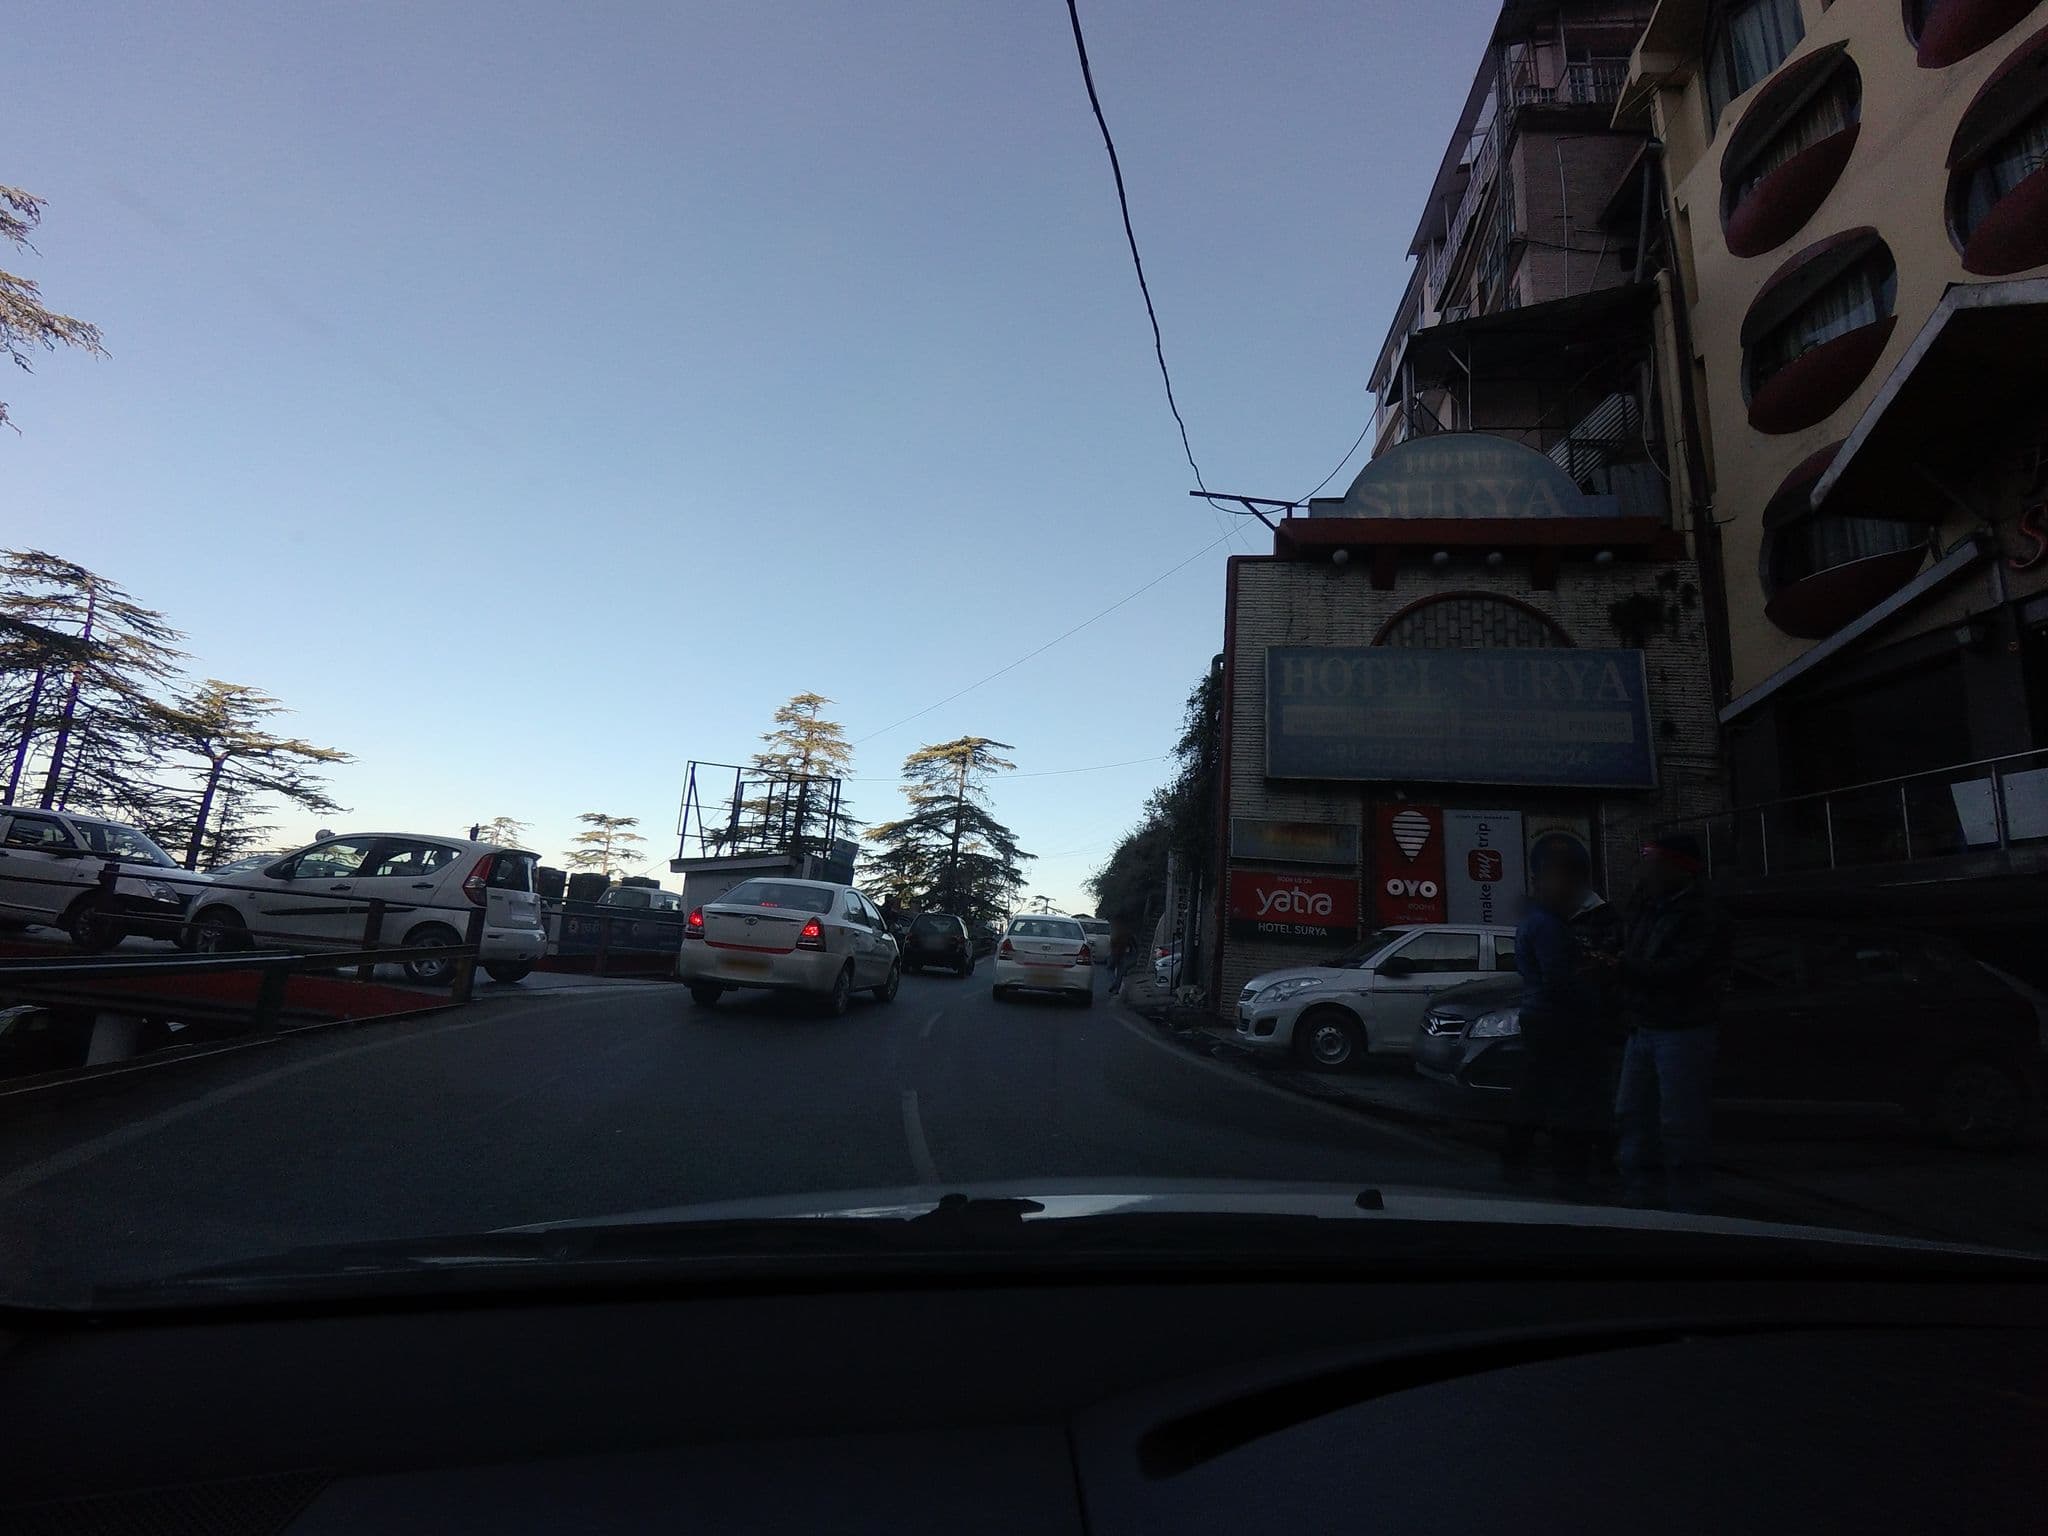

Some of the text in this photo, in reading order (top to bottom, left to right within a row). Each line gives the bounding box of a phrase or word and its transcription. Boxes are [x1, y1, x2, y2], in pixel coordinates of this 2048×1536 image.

[1358, 478, 1565, 519] SURYA
[1280, 656, 1633, 703] HOTEL SURYA
[1256, 885, 1333, 917] yatra
[1386, 877, 1438, 899] OYO
[1257, 922, 1328, 936] HOTEL SURYA
